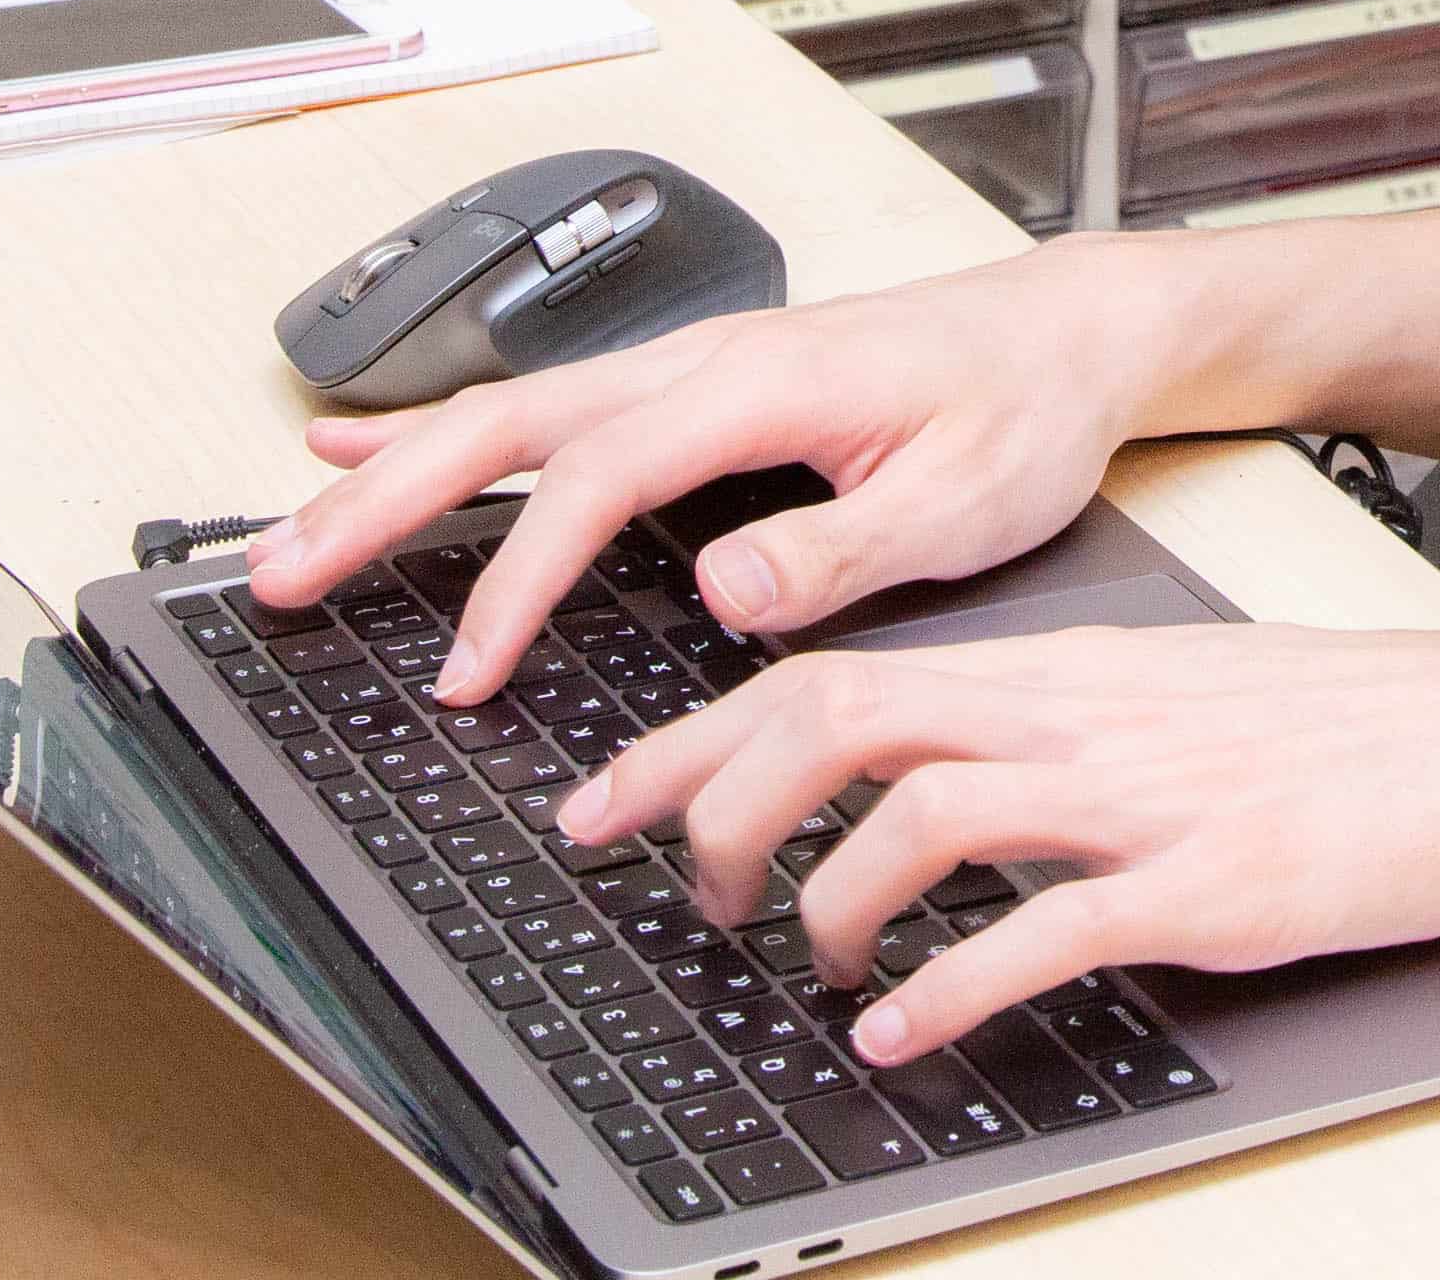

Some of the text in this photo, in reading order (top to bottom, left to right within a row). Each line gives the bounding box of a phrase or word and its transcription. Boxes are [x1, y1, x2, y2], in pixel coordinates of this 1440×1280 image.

[650, 662, 671, 672] ㄡ
[359, 686, 380, 696] ㄦ
[537, 689, 601, 708] L ㄠ
[350, 716, 410, 736] 0 ㄢ
[455, 717, 517, 736] O ㄟ
[569, 727, 593, 738] K
[384, 755, 448, 776] 9 ㄞ
[534, 765, 556, 776] ㄛ
[417, 794, 480, 815] 8 ㄚ
[524, 796, 547, 806] U
[609, 846, 632, 858] ㄗ
[791, 850, 815, 862] V
[488, 877, 510, 887] 6
[598, 881, 670, 898] T ㄔ
[773, 901, 792, 909] ㄑ
[525, 920, 548, 930] 5
[572, 931, 595, 943] ㄓ
[638, 920, 707, 943] R ㄐ
[763, 934, 787, 946] D
[880, 935, 901, 946] X
[563, 964, 584, 973] 4
[677, 965, 751, 986] E ㄍ
[603, 1010, 626, 1021] 3
[717, 1012, 794, 1034] W ㄊ
[1107, 1005, 1148, 1037] control
[643, 1056, 668, 1068] 2
[694, 1069, 717, 1082] ㄉ
[761, 1058, 838, 1081] Q ㄆ
[685, 1107, 707, 1116] 1
[736, 1119, 757, 1131] ㄅ
